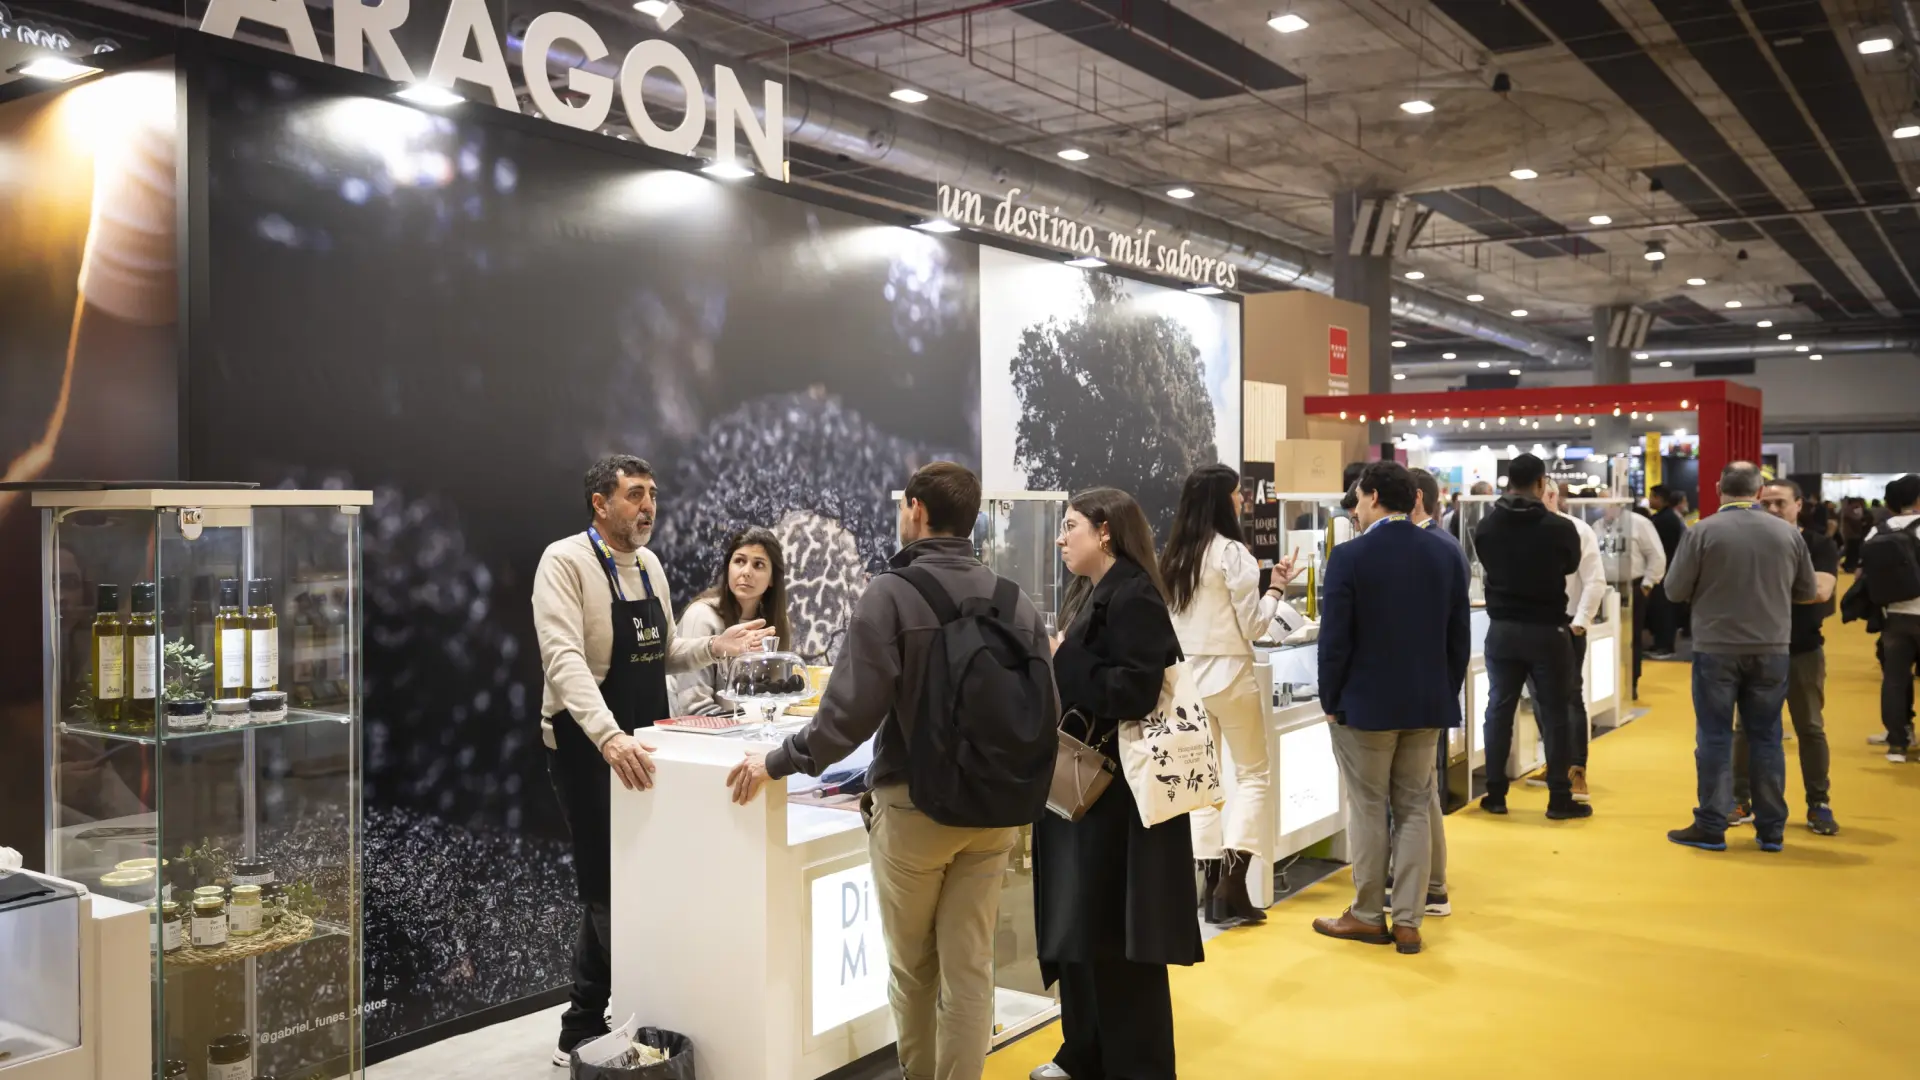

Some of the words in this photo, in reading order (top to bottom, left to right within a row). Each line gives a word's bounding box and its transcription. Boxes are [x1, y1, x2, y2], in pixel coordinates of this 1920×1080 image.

[938, 184, 985, 226] un
[994, 188, 1101, 258] destino,
[1109, 228, 1156, 268] mil
[1157, 240, 1237, 289] sabores
[841, 880, 869, 929] Di
